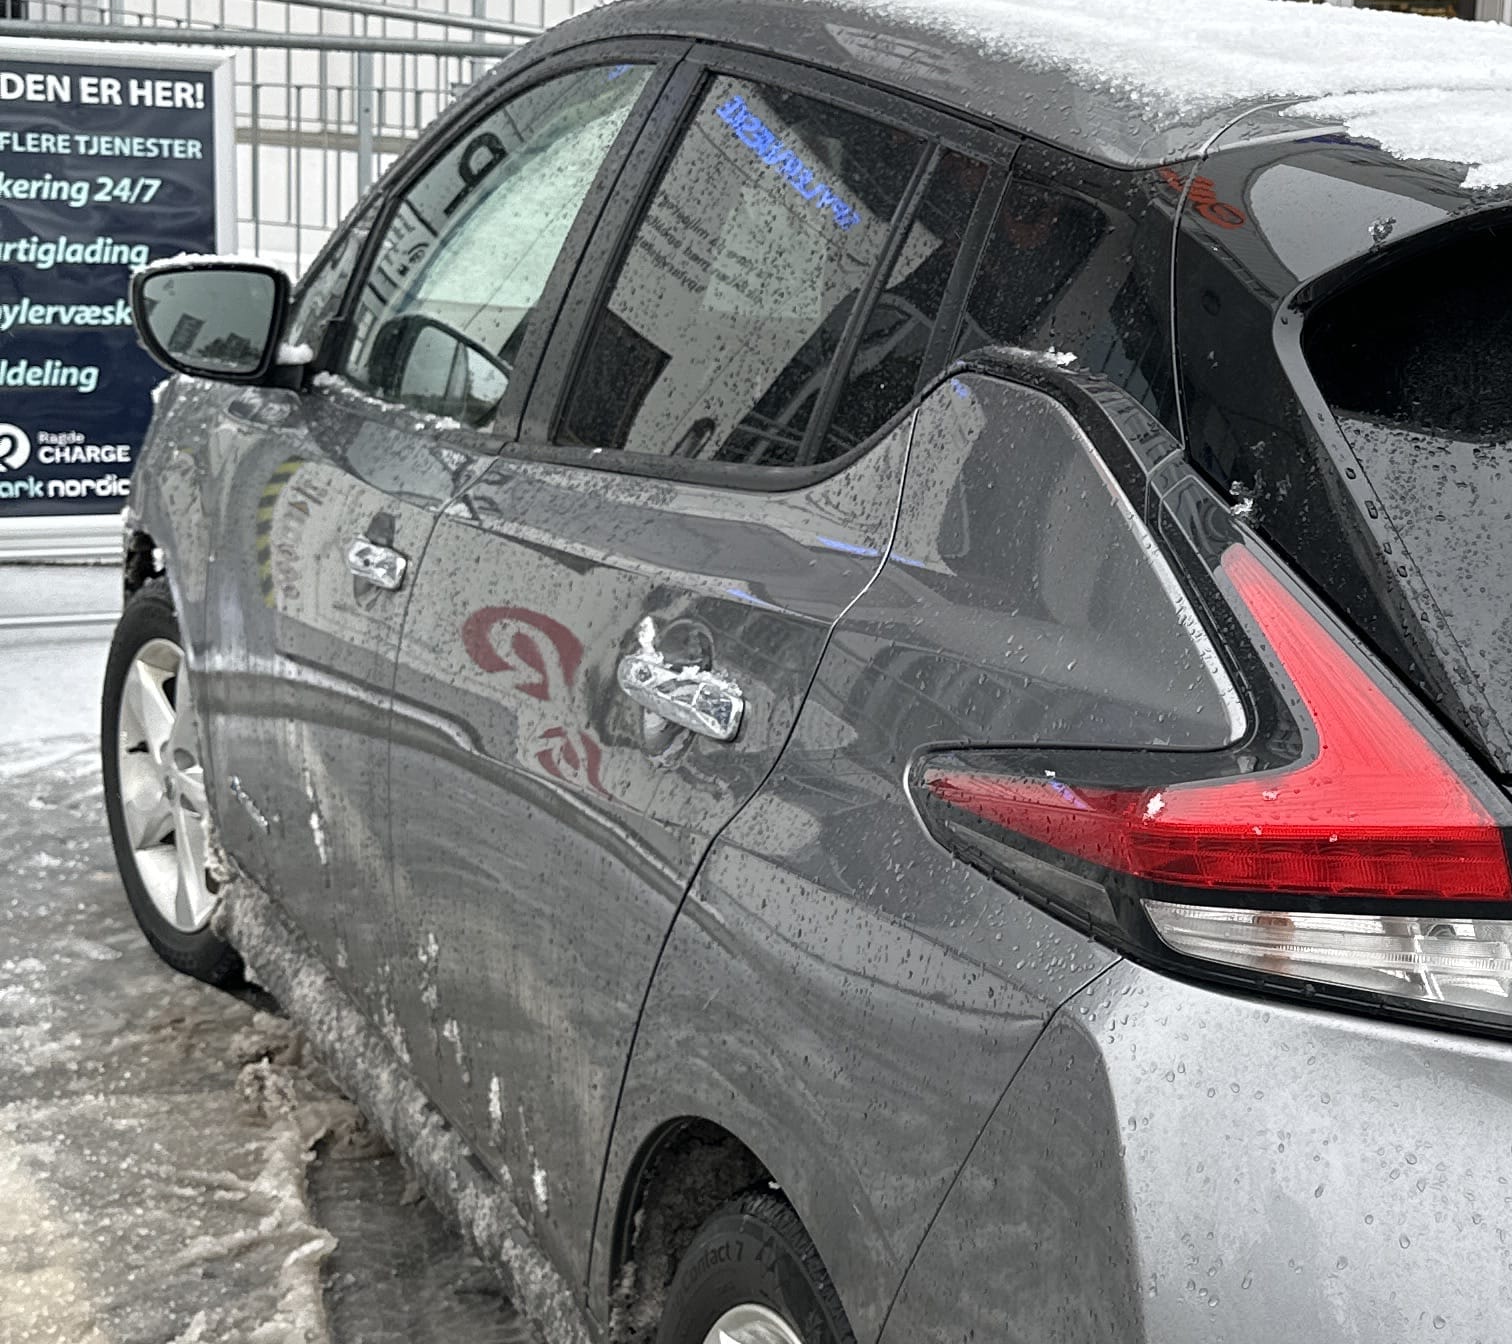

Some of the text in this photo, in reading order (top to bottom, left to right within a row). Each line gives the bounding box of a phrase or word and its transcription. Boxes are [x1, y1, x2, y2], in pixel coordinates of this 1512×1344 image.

[0, 72, 205, 109] DEN ER HER!
[0, 131, 203, 159] FLERE TJENESTER
[93, 176, 162, 203] 24/7
[0, 297, 133, 331] ylervæsk
[38, 445, 131, 463] CHARGE
[48, 473, 130, 497] nordic
